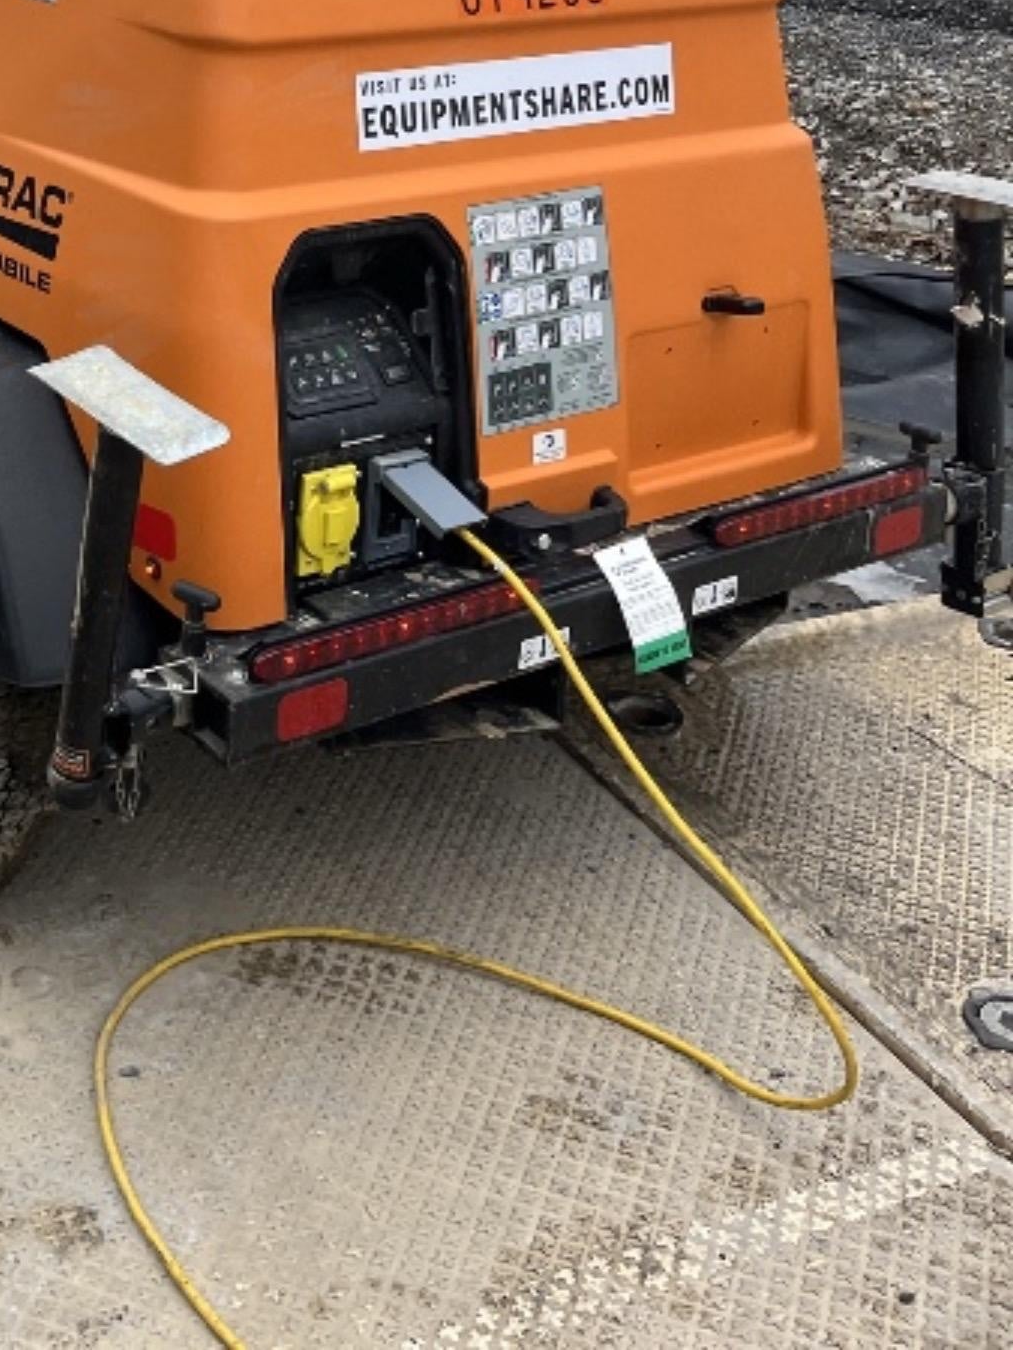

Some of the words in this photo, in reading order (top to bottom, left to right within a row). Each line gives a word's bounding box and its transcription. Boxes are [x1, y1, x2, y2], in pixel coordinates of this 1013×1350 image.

[360, 77, 402, 96] VISIT
[409, 75, 427, 91] US
[433, 73, 457, 89] AT:
[361, 73, 671, 140] EQUIPMENTSHARE.COM
